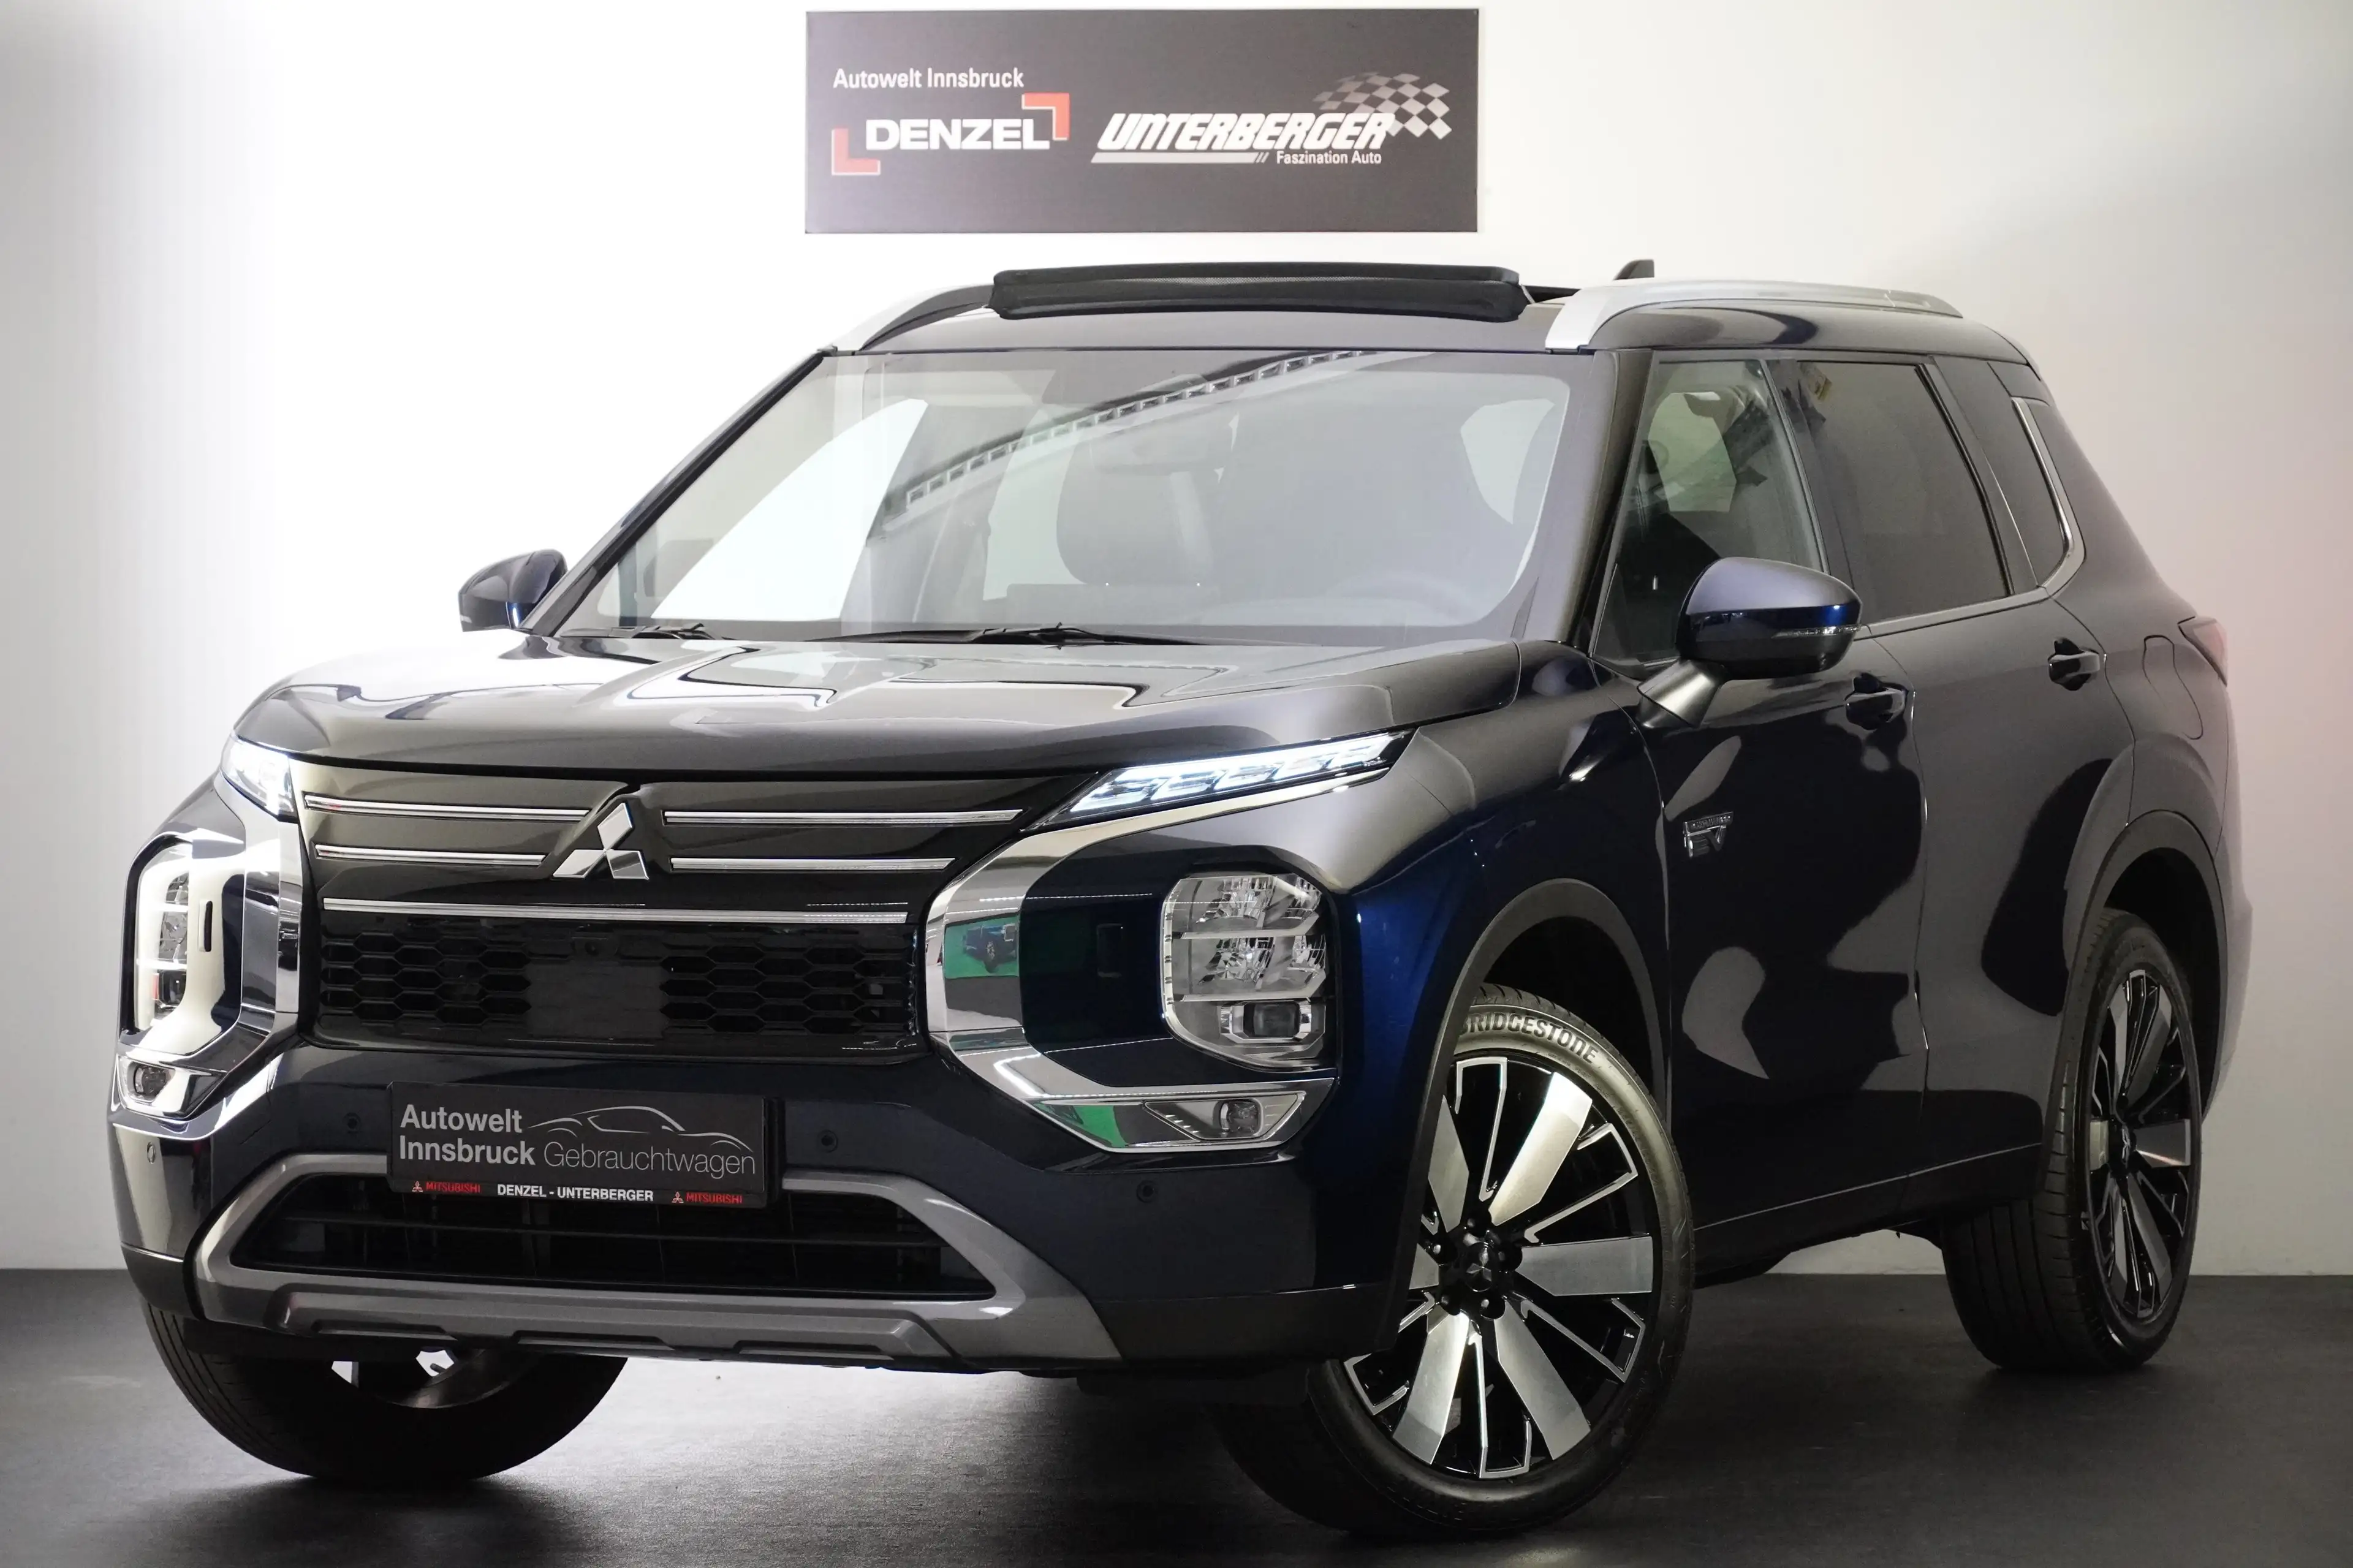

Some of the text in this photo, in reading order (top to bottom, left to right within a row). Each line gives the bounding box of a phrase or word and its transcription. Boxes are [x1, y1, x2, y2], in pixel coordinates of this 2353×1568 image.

[833, 67, 1025, 89] Autowelt Innsbruck
[865, 118, 1051, 151] DENZEL
[1096, 112, 1396, 151] UNTERBERGER
[1276, 150, 1382, 165] Faszination Auto
[400, 1104, 523, 1134] Autowelt
[399, 1135, 756, 1180] Innsbruck Gebrauchtwagen
[425, 1181, 480, 1193] MITSUBISHI
[496, 1183, 547, 1198] DENZEL
[556, 1186, 654, 1202] UNTERBERGER
[686, 1192, 742, 1204] MITSUBISHI
